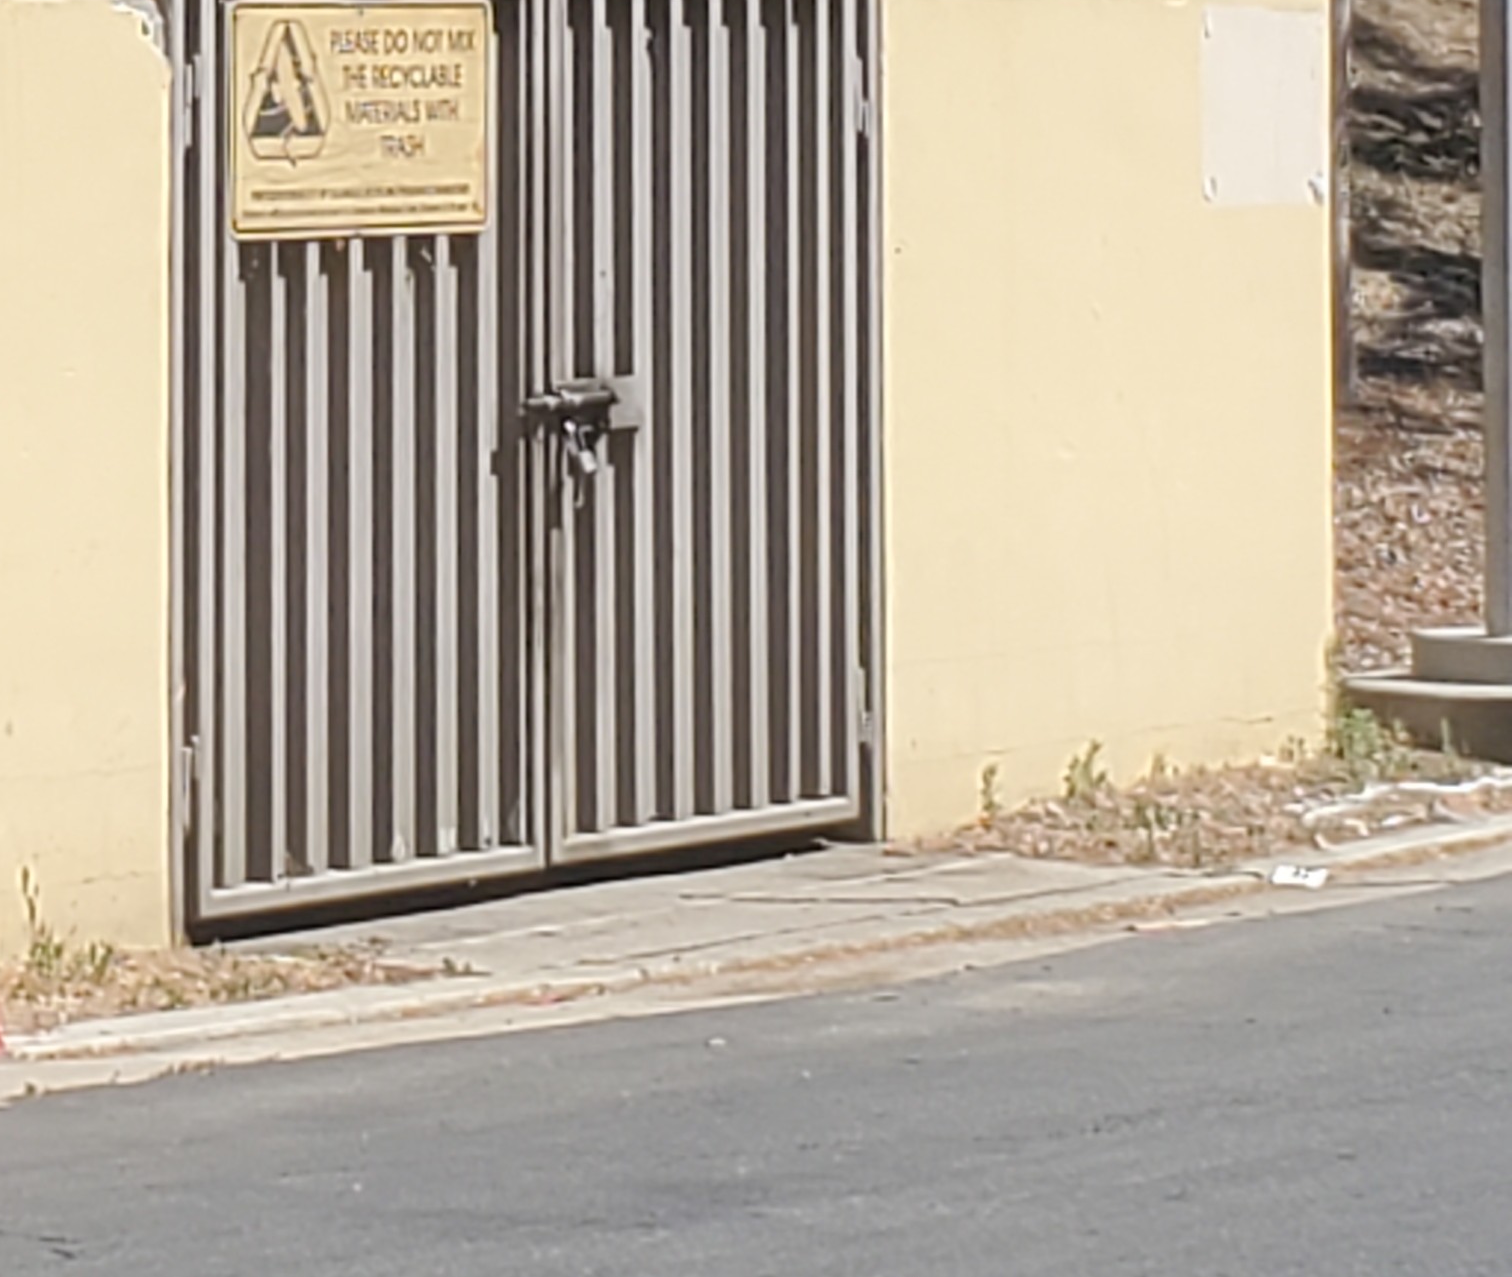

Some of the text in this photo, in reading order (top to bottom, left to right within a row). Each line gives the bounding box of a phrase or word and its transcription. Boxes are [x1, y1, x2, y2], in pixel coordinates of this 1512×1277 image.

[330, 28, 476, 55] PLEASE DO NOT MIX
[342, 63, 462, 90] THE RECYCLABLE
[345, 98, 459, 124] MATERIALS WITH
[380, 134, 426, 158] TRASH
